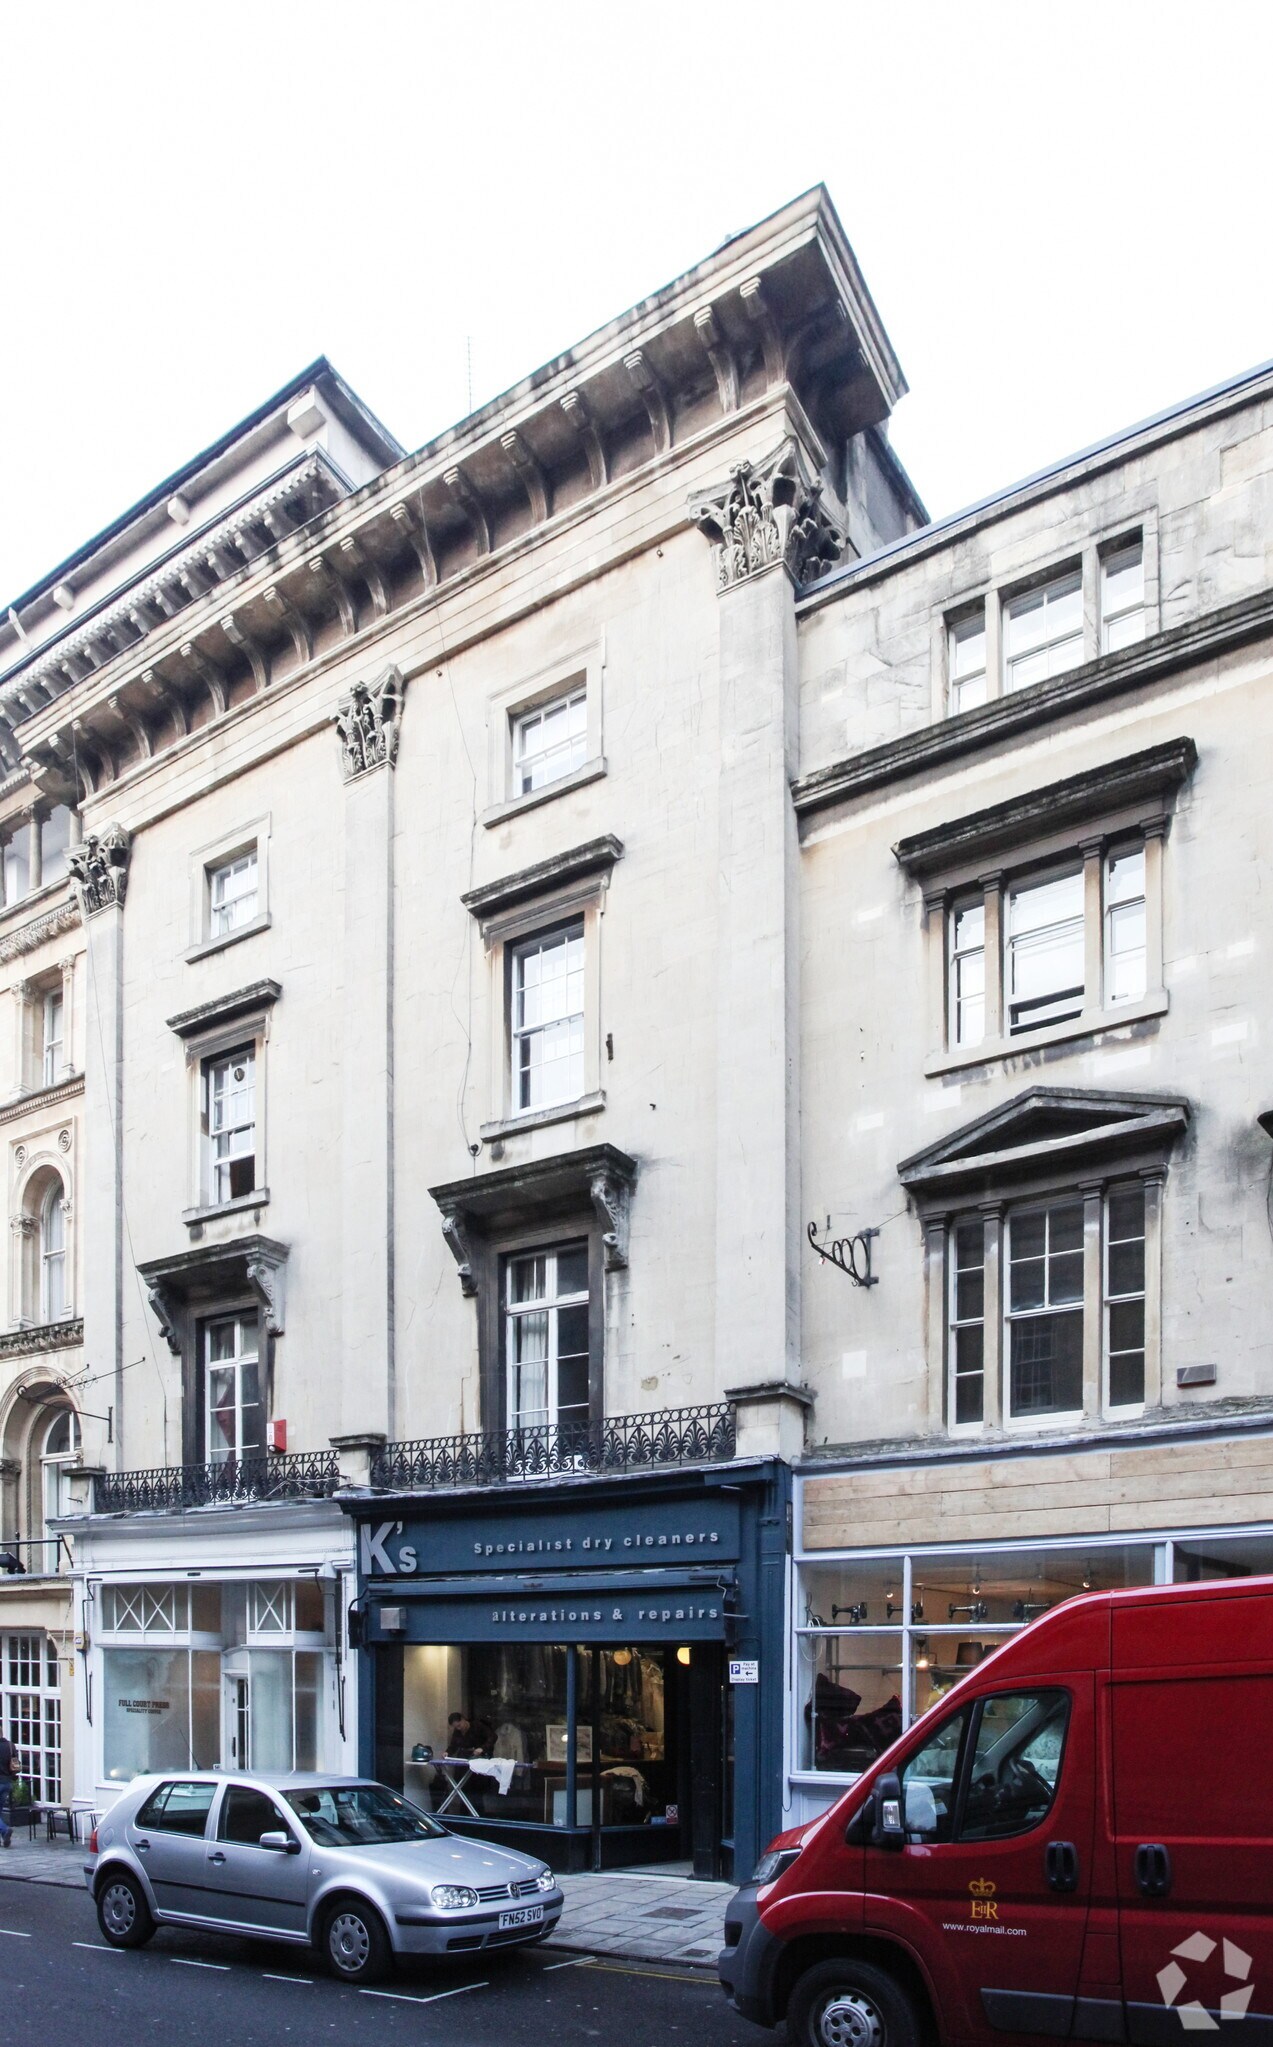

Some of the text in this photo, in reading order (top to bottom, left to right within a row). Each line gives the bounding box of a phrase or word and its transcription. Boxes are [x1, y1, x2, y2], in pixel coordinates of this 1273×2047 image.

[361, 1521, 418, 1575] K's
[474, 1532, 719, 1556] Specialist dry cleaners
[492, 1606, 718, 1622] alterations & repairs
[118, 1699, 170, 1709] FULL COURT PRESS
[502, 1911, 525, 1926] FN52
[942, 1922, 1027, 1936] www.royalmail.com
